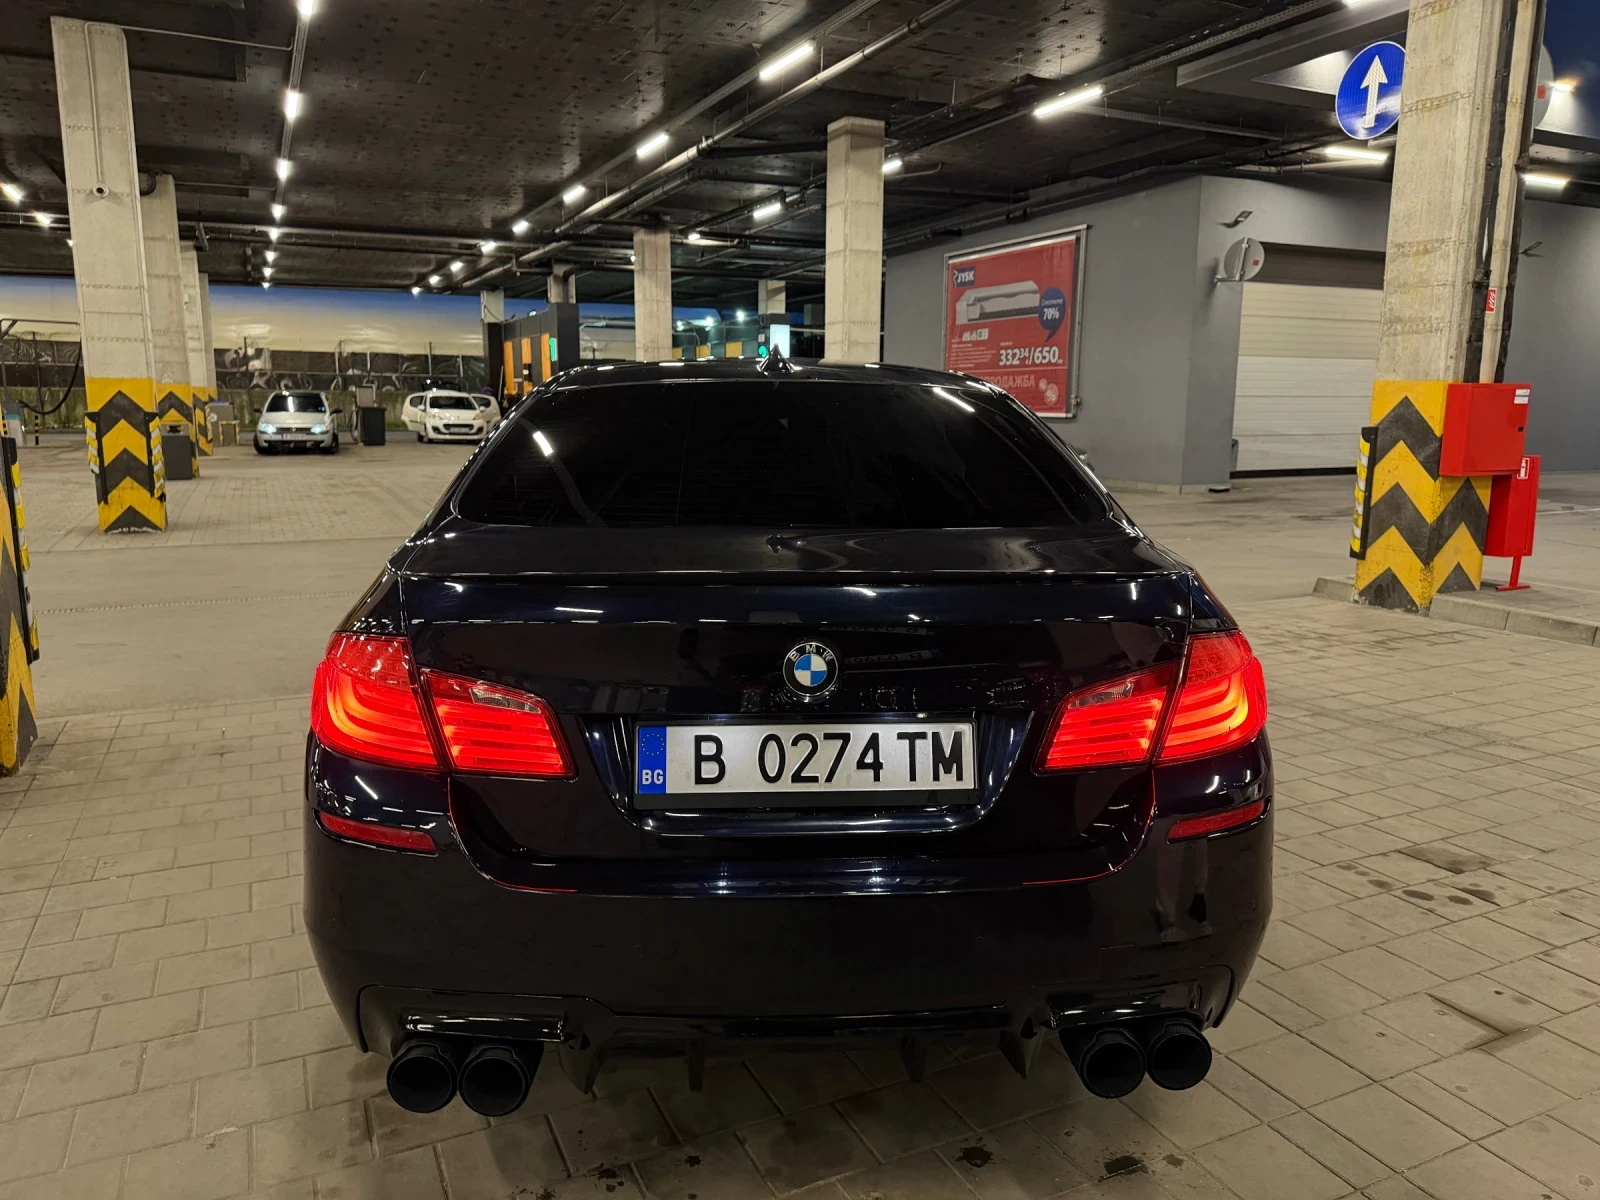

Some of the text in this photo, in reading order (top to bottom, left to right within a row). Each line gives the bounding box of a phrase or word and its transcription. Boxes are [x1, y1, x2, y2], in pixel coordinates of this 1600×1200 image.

[957, 270, 975, 283] JYSK
[1043, 307, 1060, 320] 70%
[788, 644, 834, 662] BMW
[694, 731, 964, 785] B 0274 TM
[641, 769, 664, 785] BG
